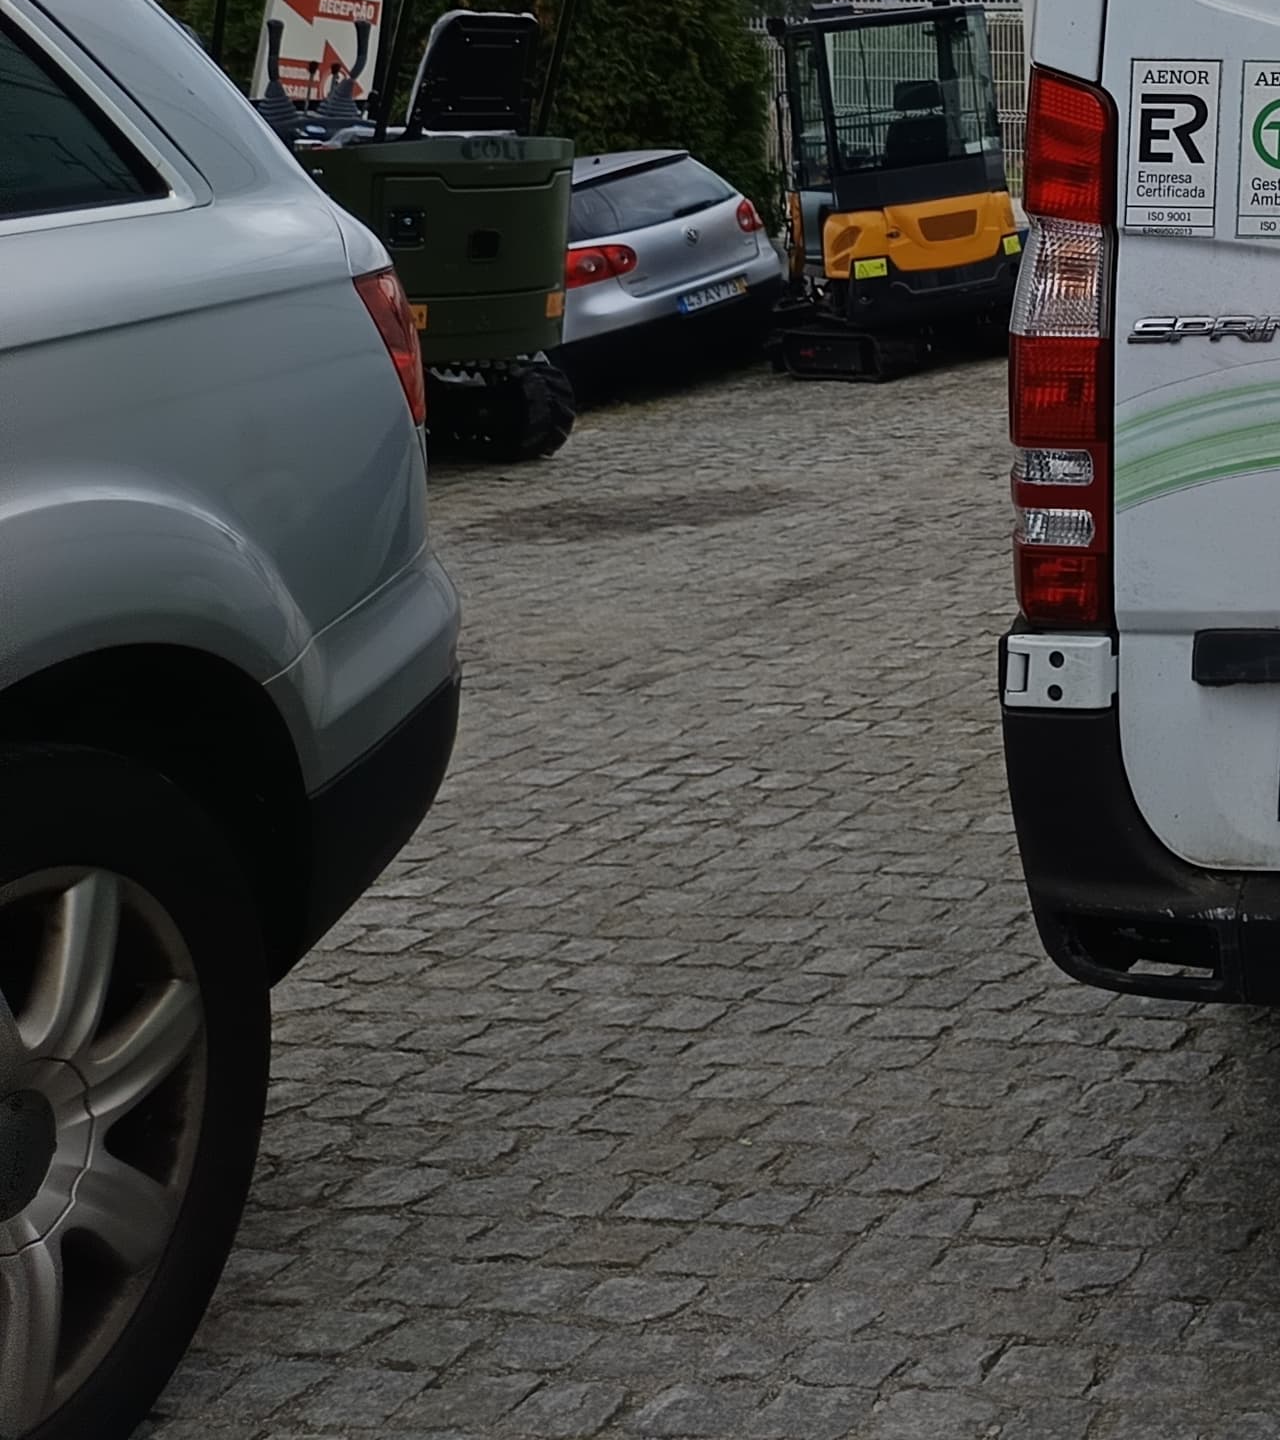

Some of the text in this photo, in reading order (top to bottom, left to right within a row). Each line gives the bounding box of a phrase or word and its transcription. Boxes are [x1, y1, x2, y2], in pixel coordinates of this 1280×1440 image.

[1142, 70, 1210, 85] AENOR
[1137, 170, 1193, 187] Empresa
[1136, 184, 1206, 198] Certificada
[1147, 211, 1192, 222] ISO 9001
[1260, 221, 1277, 232] ISO
